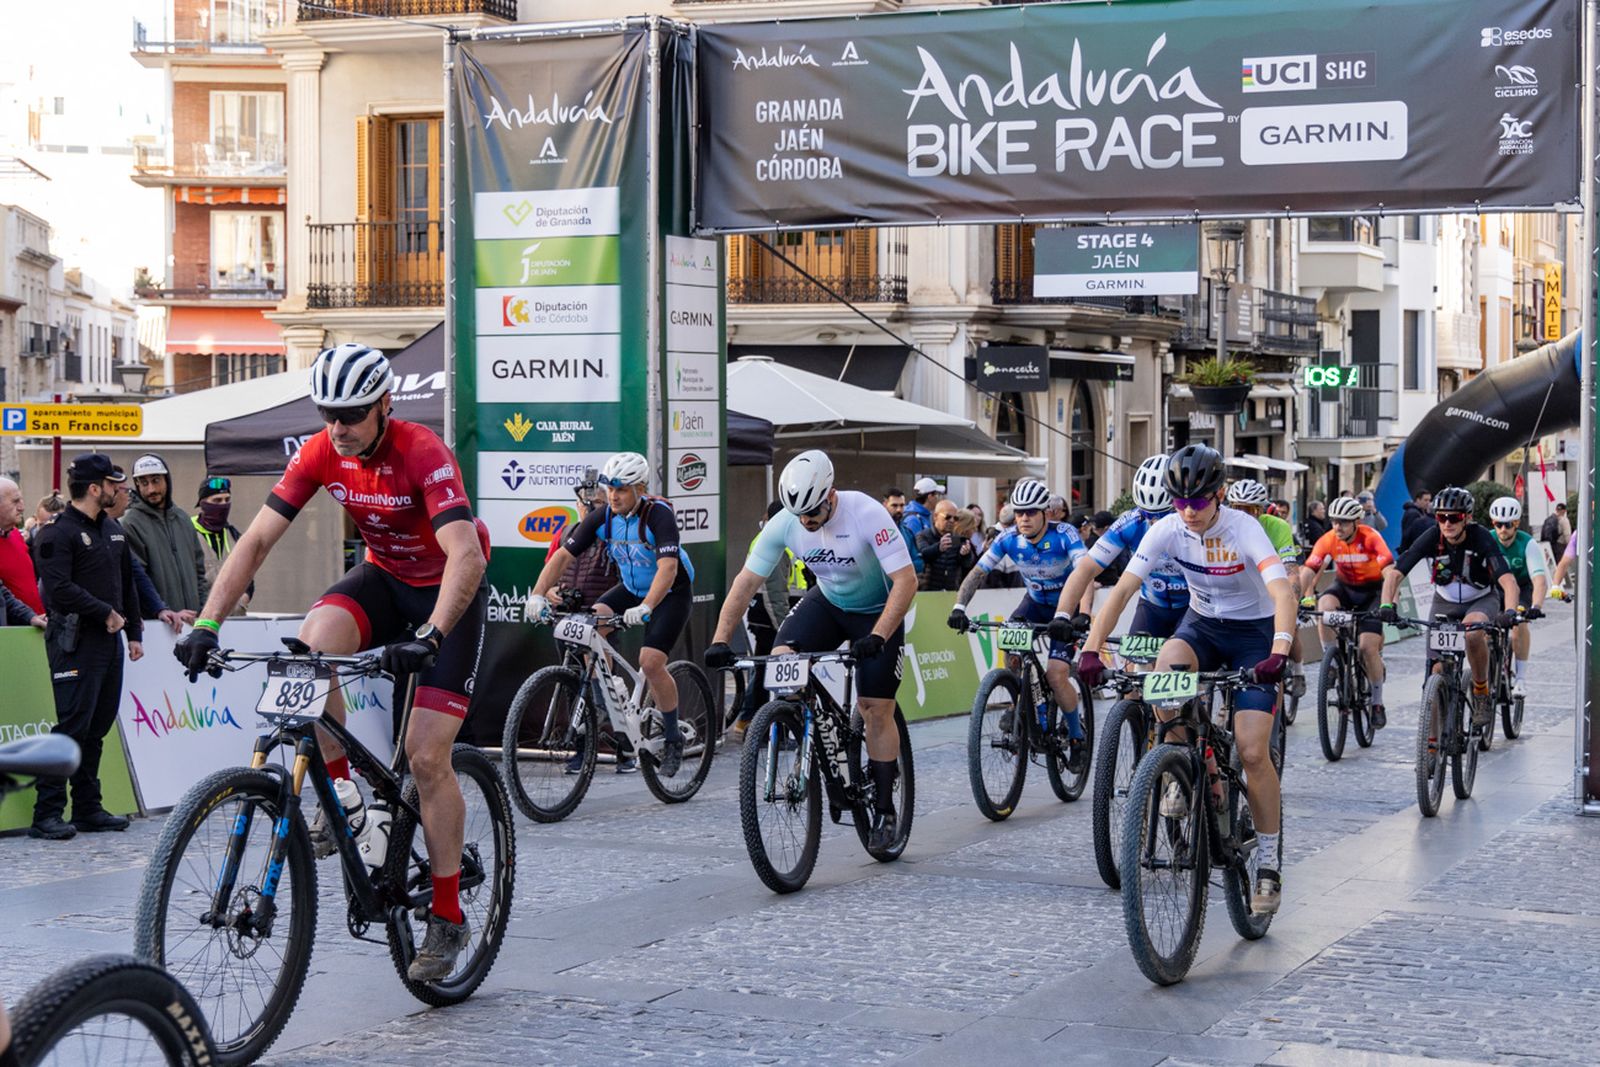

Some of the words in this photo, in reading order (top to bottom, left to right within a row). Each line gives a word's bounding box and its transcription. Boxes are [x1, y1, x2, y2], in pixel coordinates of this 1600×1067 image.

[733, 45, 820, 71] Andalucía
[902, 32, 1223, 121] Andalucía
[1255, 62, 1310, 86] UCI
[1325, 60, 1367, 80] SHC
[1495, 88, 1538, 97] CICLISMO
[484, 90, 612, 130] Andalucía
[756, 98, 844, 123] GRANADA
[1227, 115, 1239, 123] BY
[774, 123, 824, 152] JAÉN
[1260, 121, 1389, 146] GARMIN
[908, 120, 1037, 177] BIKE
[1056, 112, 1224, 172] RACE
[756, 154, 843, 181] CÓRDOBA
[536, 205, 588, 220] Diputación
[536, 218, 548, 227] de
[550, 216, 591, 227] Granada
[1077, 234, 1137, 249] STAGE
[1141, 233, 1153, 247] 4
[1091, 251, 1139, 269] JAÉN
[1086, 279, 1145, 290] GARMIN
[535, 301, 588, 315] Diputación
[1547, 266, 1559, 337] AMATE
[535, 314, 546, 323] de
[549, 312, 588, 323] Córdoba
[670, 310, 713, 326] GARMIN
[492, 359, 603, 379] GARMIN
[33, 409, 92, 417] aparcamiento
[97, 409, 138, 417] municipal
[681, 410, 703, 430] Jaén
[1445, 407, 1510, 430] garmin.com
[32, 421, 59, 431] San
[69, 421, 138, 432] Francisco
[536, 422, 558, 430] CAJA
[560, 421, 593, 430] RURAL
[552, 432, 575, 442] JAÉN
[349, 490, 412, 506] LumiNova
[488, 606, 520, 622] BIKE
[562, 622, 585, 640] 893
[1002, 630, 1027, 646] 2209
[1126, 635, 1157, 651] 2210
[1438, 633, 1458, 647] 817
[918, 650, 956, 665] DIPUTACIÓN
[775, 662, 799, 682] 896
[922, 671, 934, 681] DE
[934, 668, 949, 680] JAÉN
[1151, 674, 1191, 693] 2215
[276, 681, 315, 709] 839
[130, 687, 243, 738] Andalucía
[166, 1001, 212, 1067] MAXXI
